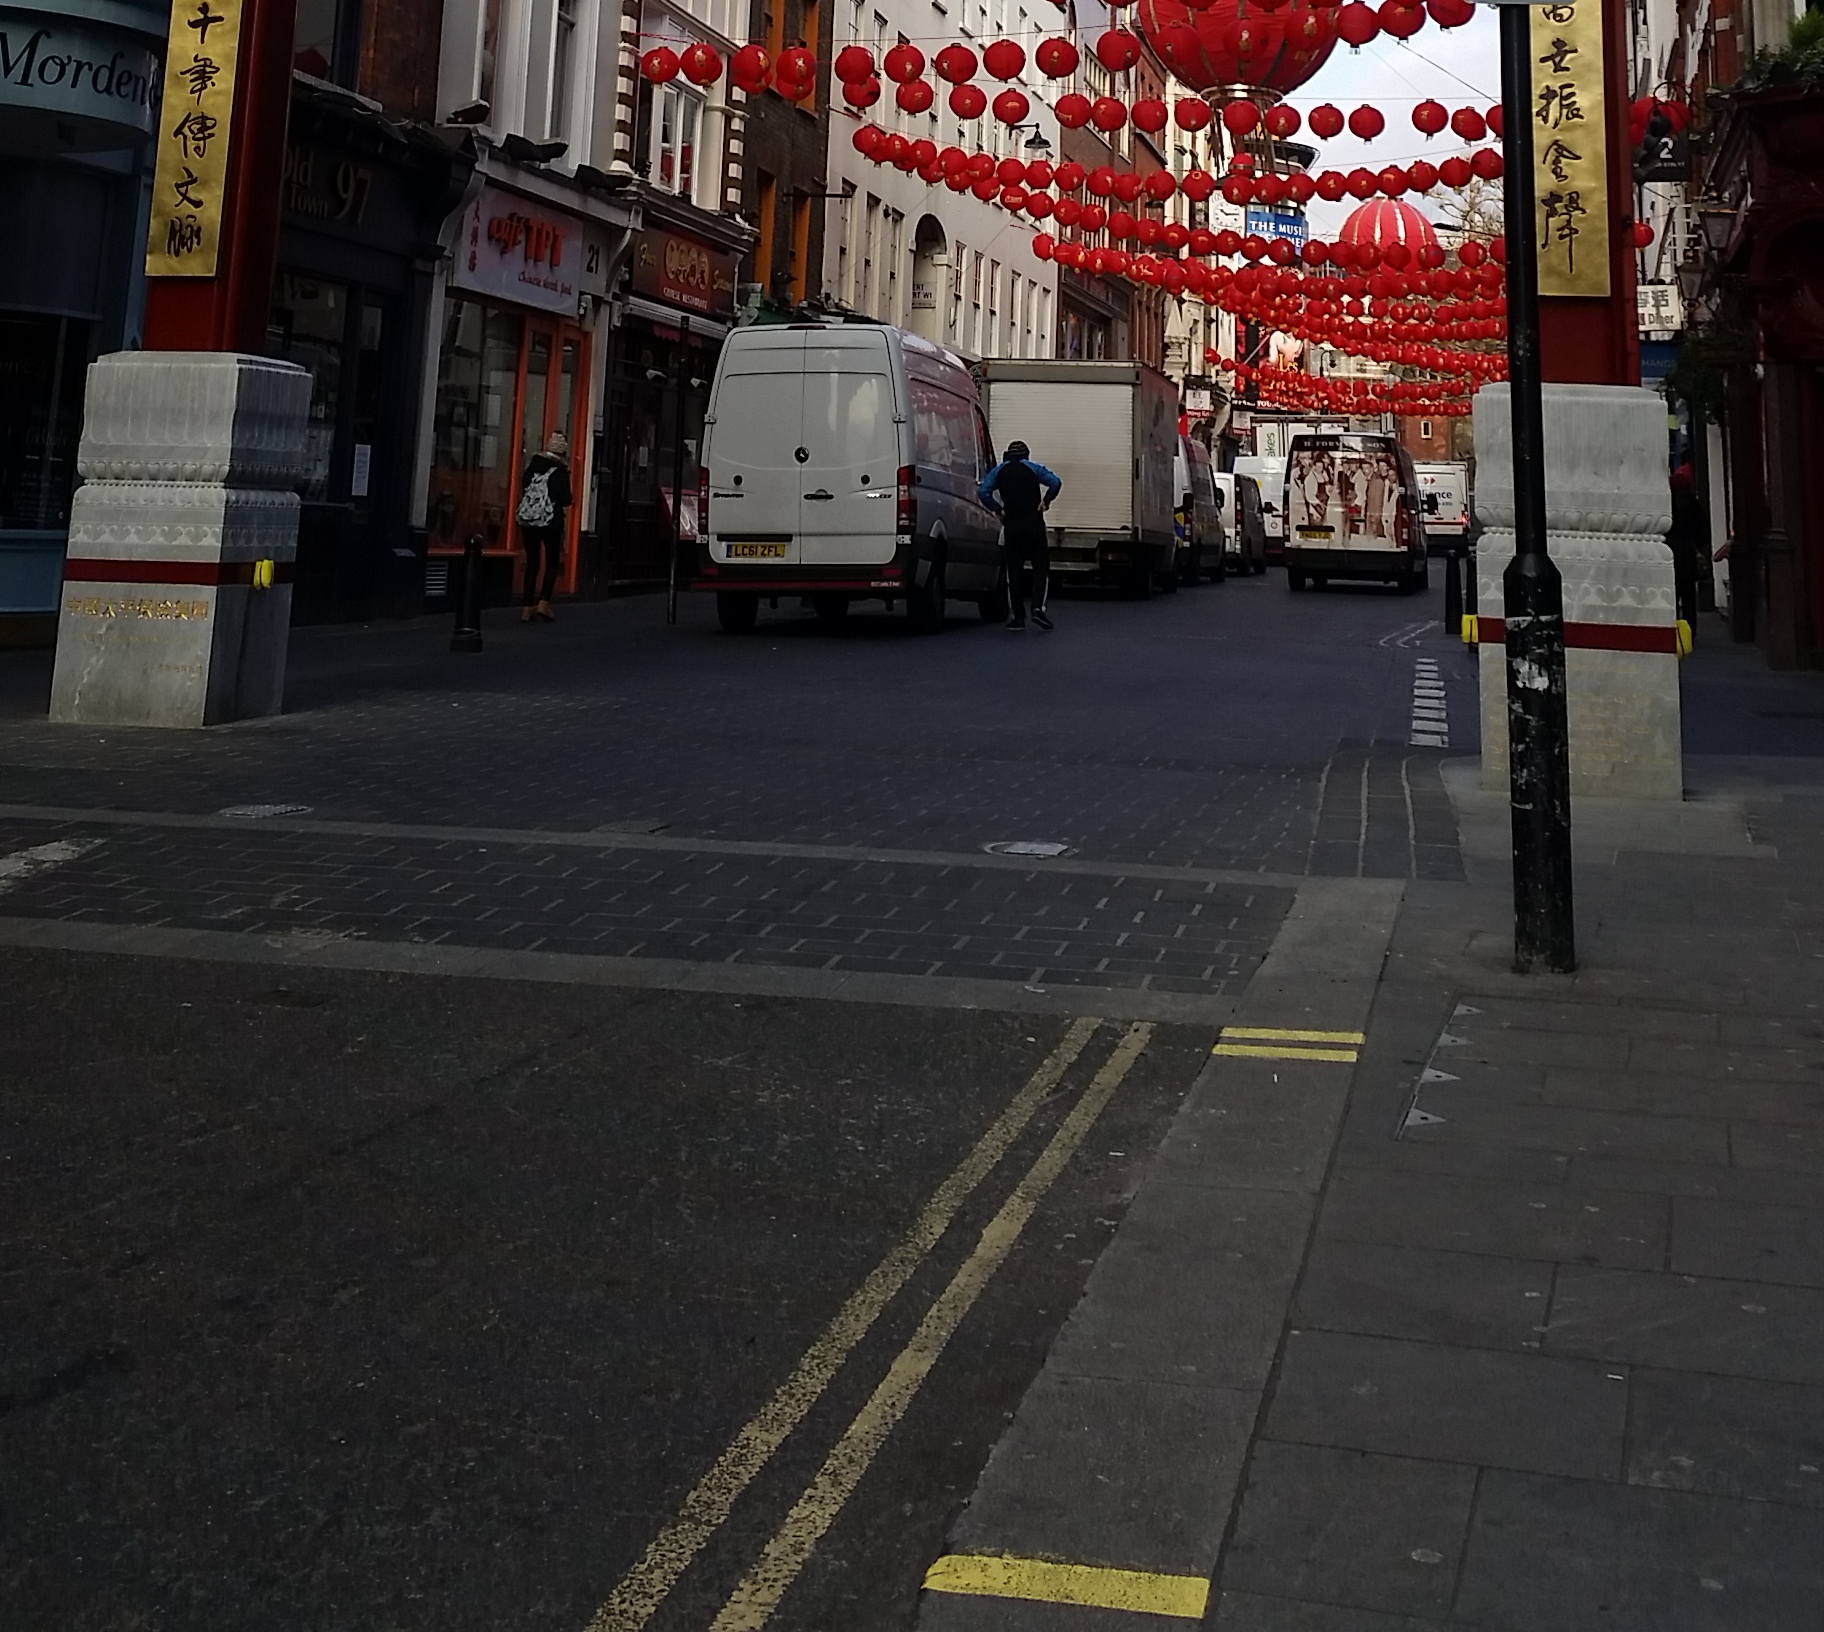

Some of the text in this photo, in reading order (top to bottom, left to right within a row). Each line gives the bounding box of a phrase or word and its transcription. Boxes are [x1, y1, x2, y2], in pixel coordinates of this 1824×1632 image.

[0, 30, 147, 106] Morden
[1658, 136, 1674, 159] 2
[290, 183, 329, 218] Town
[335, 162, 373, 224] 97
[1249, 220, 1276, 232] THE
[525, 218, 566, 268] TPT
[586, 244, 601, 275] 21
[1278, 353, 1299, 374] Les
[734, 545, 781, 557] LC61 ZFL
